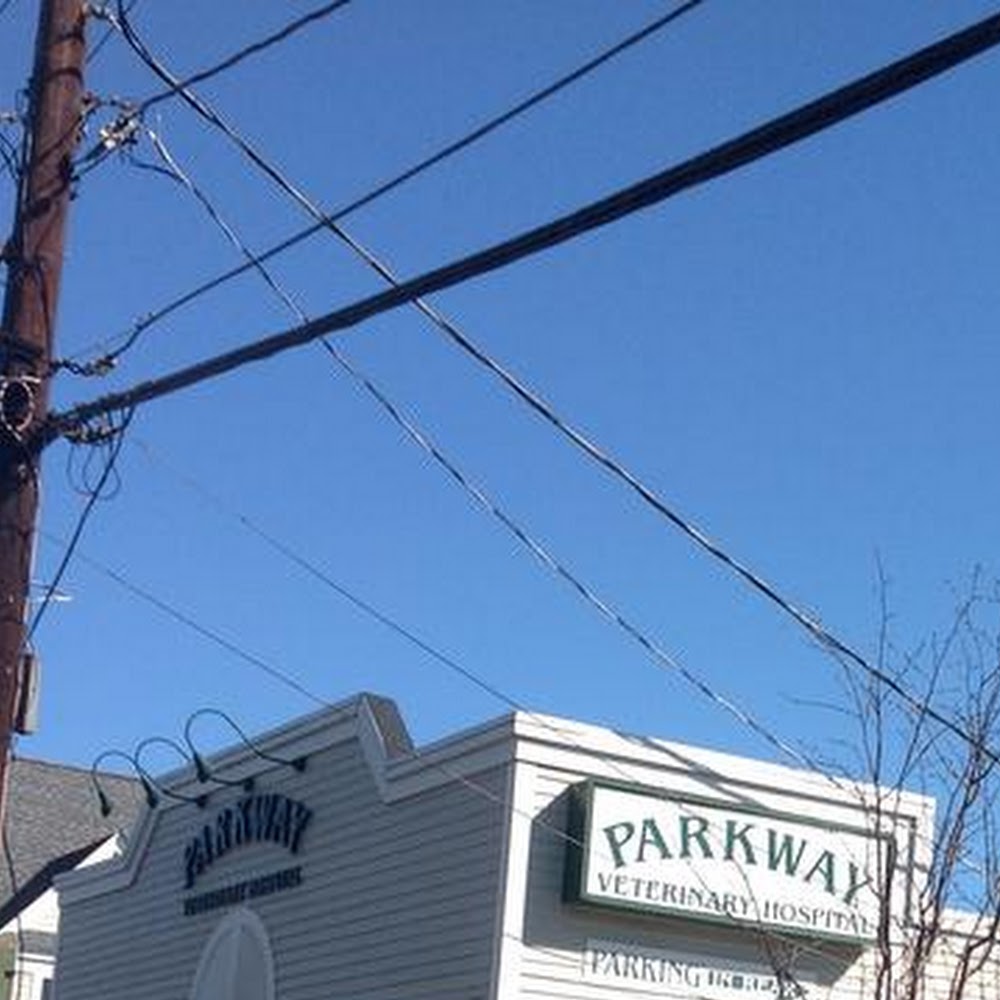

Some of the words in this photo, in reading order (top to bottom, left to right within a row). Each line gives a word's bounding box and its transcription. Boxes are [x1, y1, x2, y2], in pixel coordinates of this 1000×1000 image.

[602, 815, 872, 905] PARKWAY
[597, 871, 750, 916] VETERINARY
[763, 900, 874, 936] HOSPITAL
[591, 948, 701, 988] PARKING
